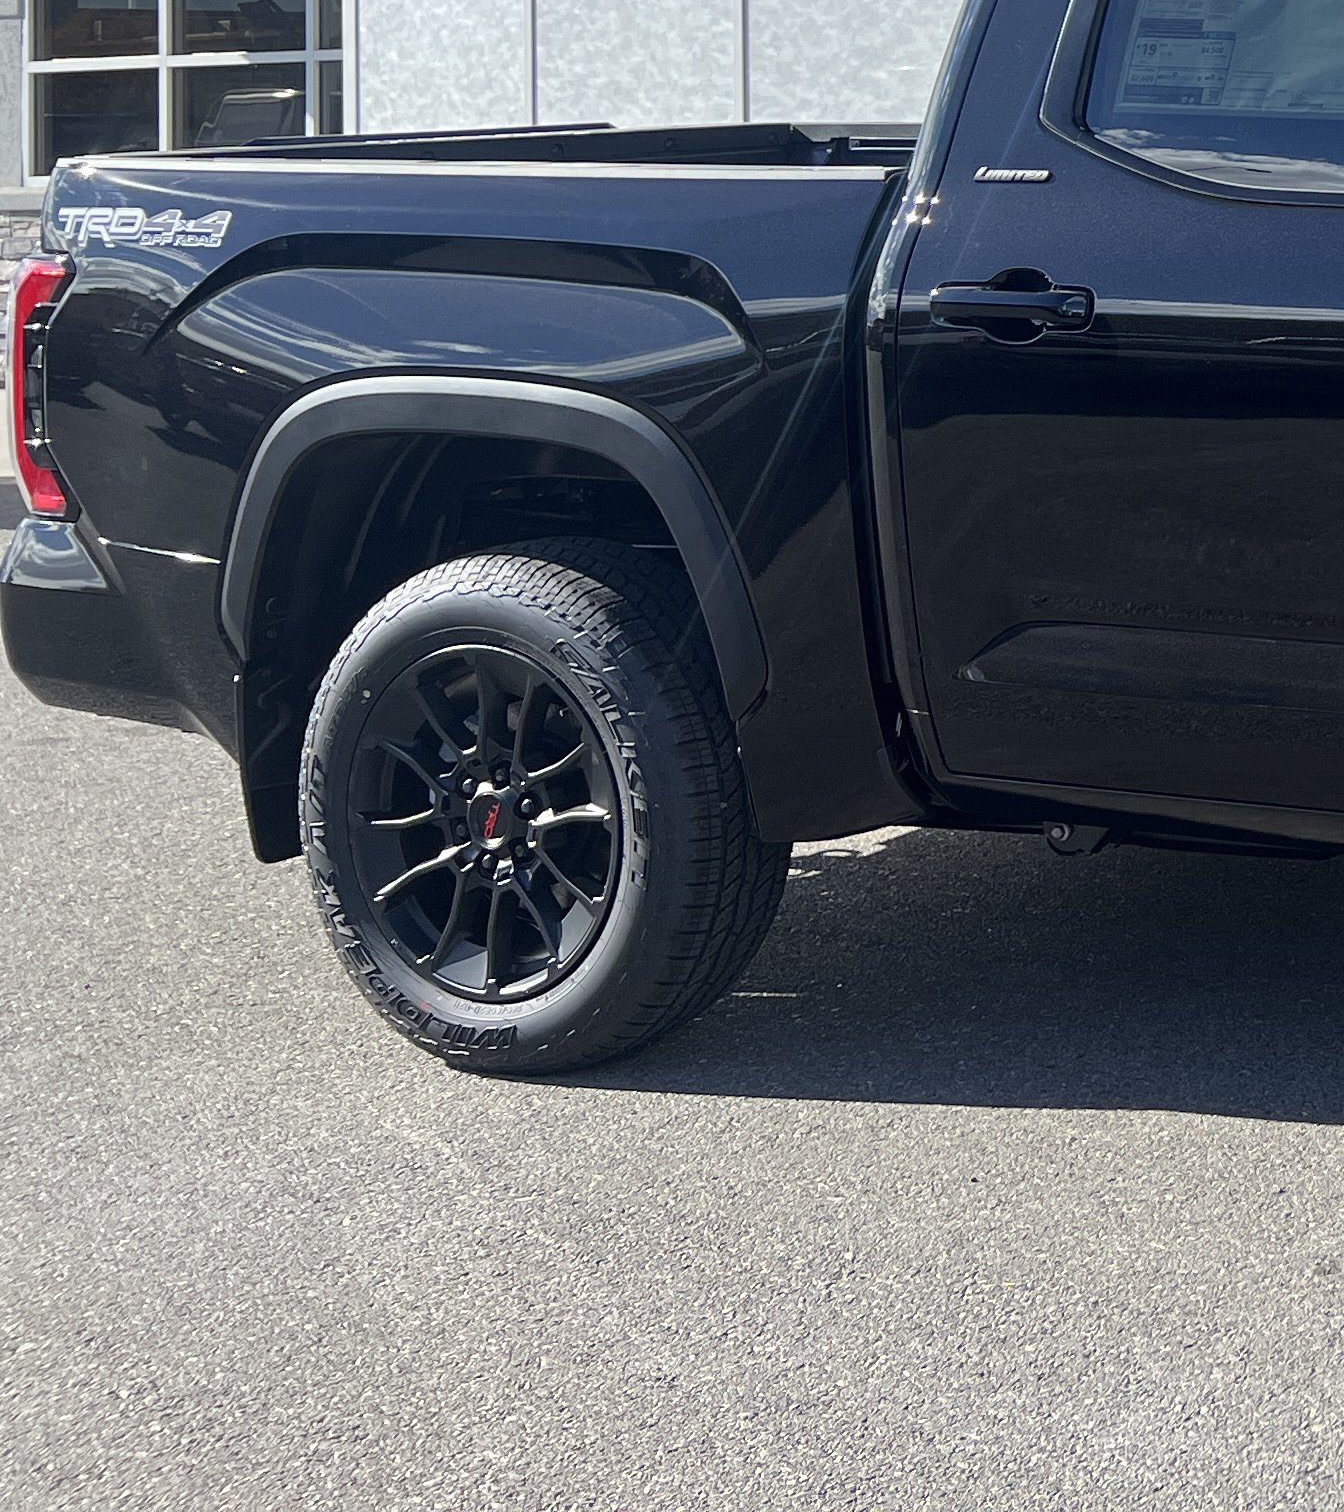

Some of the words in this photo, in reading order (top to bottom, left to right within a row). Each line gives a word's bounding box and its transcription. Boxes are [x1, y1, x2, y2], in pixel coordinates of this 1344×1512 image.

[58, 207, 146, 248] TRD
[139, 234, 173, 247] OFF
[173, 234, 222, 247] ROAD
